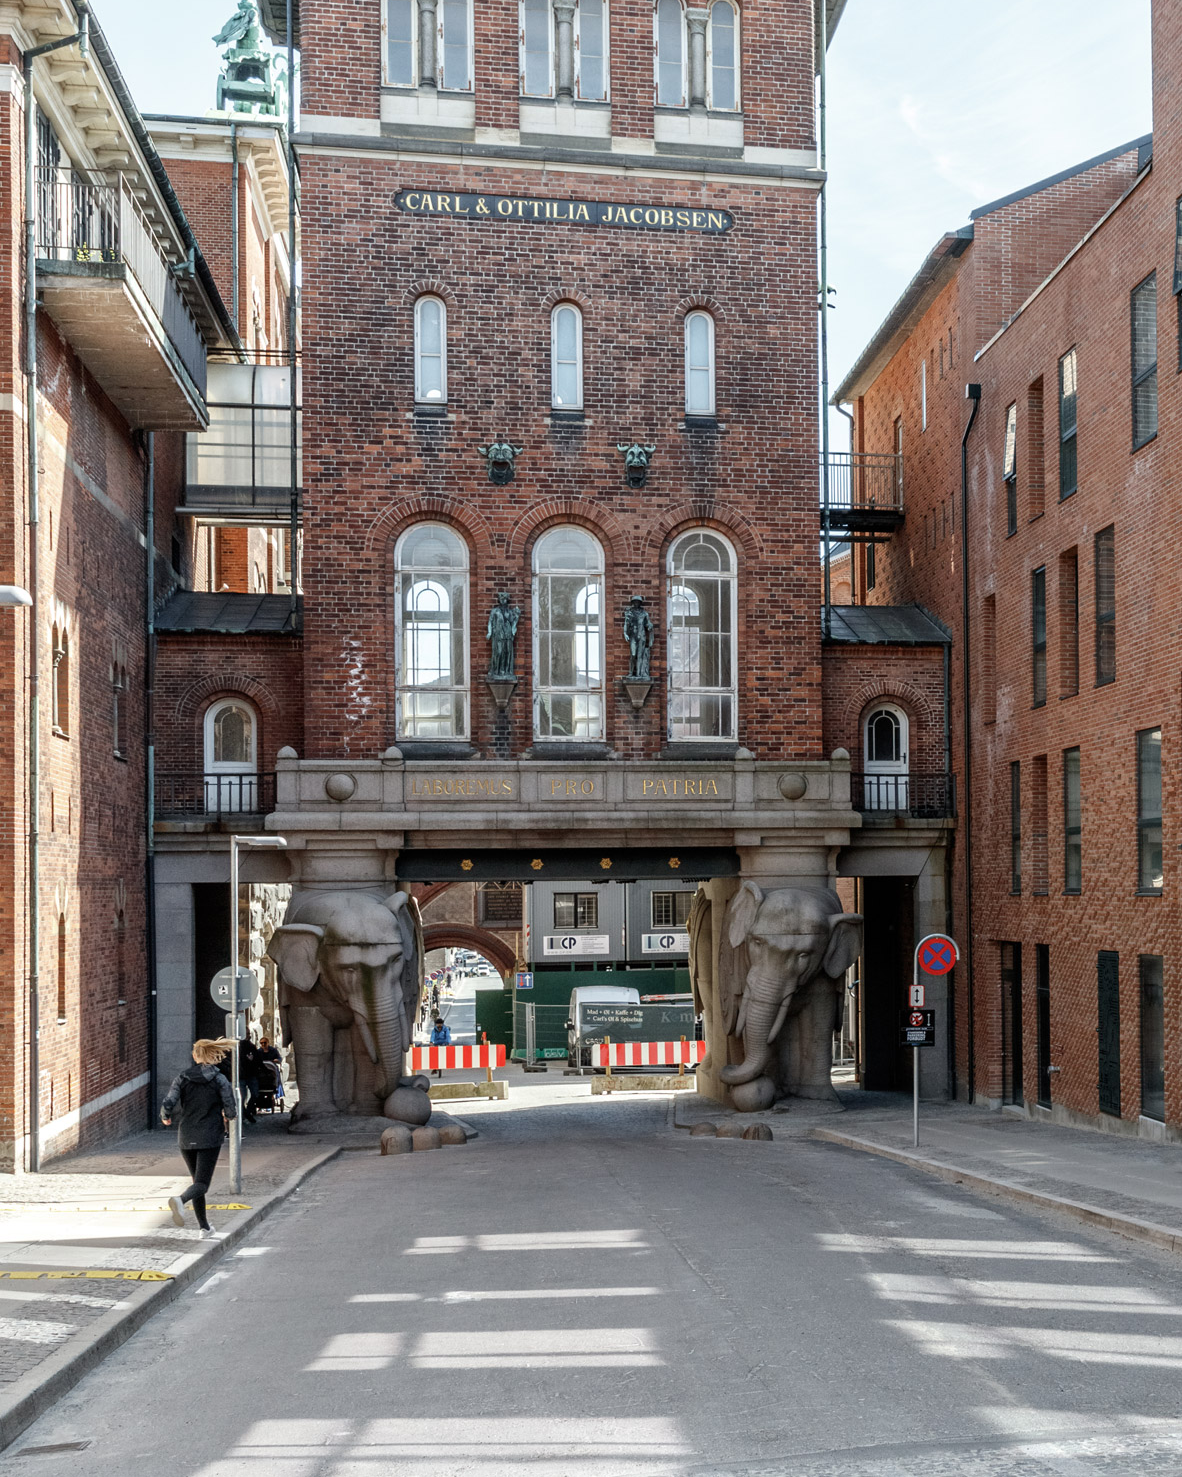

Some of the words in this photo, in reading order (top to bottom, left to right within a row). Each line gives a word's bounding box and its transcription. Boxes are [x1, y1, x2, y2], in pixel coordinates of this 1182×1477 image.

[405, 193, 469, 213] CARL
[476, 197, 491, 214] &
[498, 199, 590, 221] OTTILIA
[602, 205, 723, 229] JACOBSEN
[412, 778, 513, 795] LABOREMUS
[551, 779, 594, 795] PRO
[642, 779, 719, 795] PATRIA
